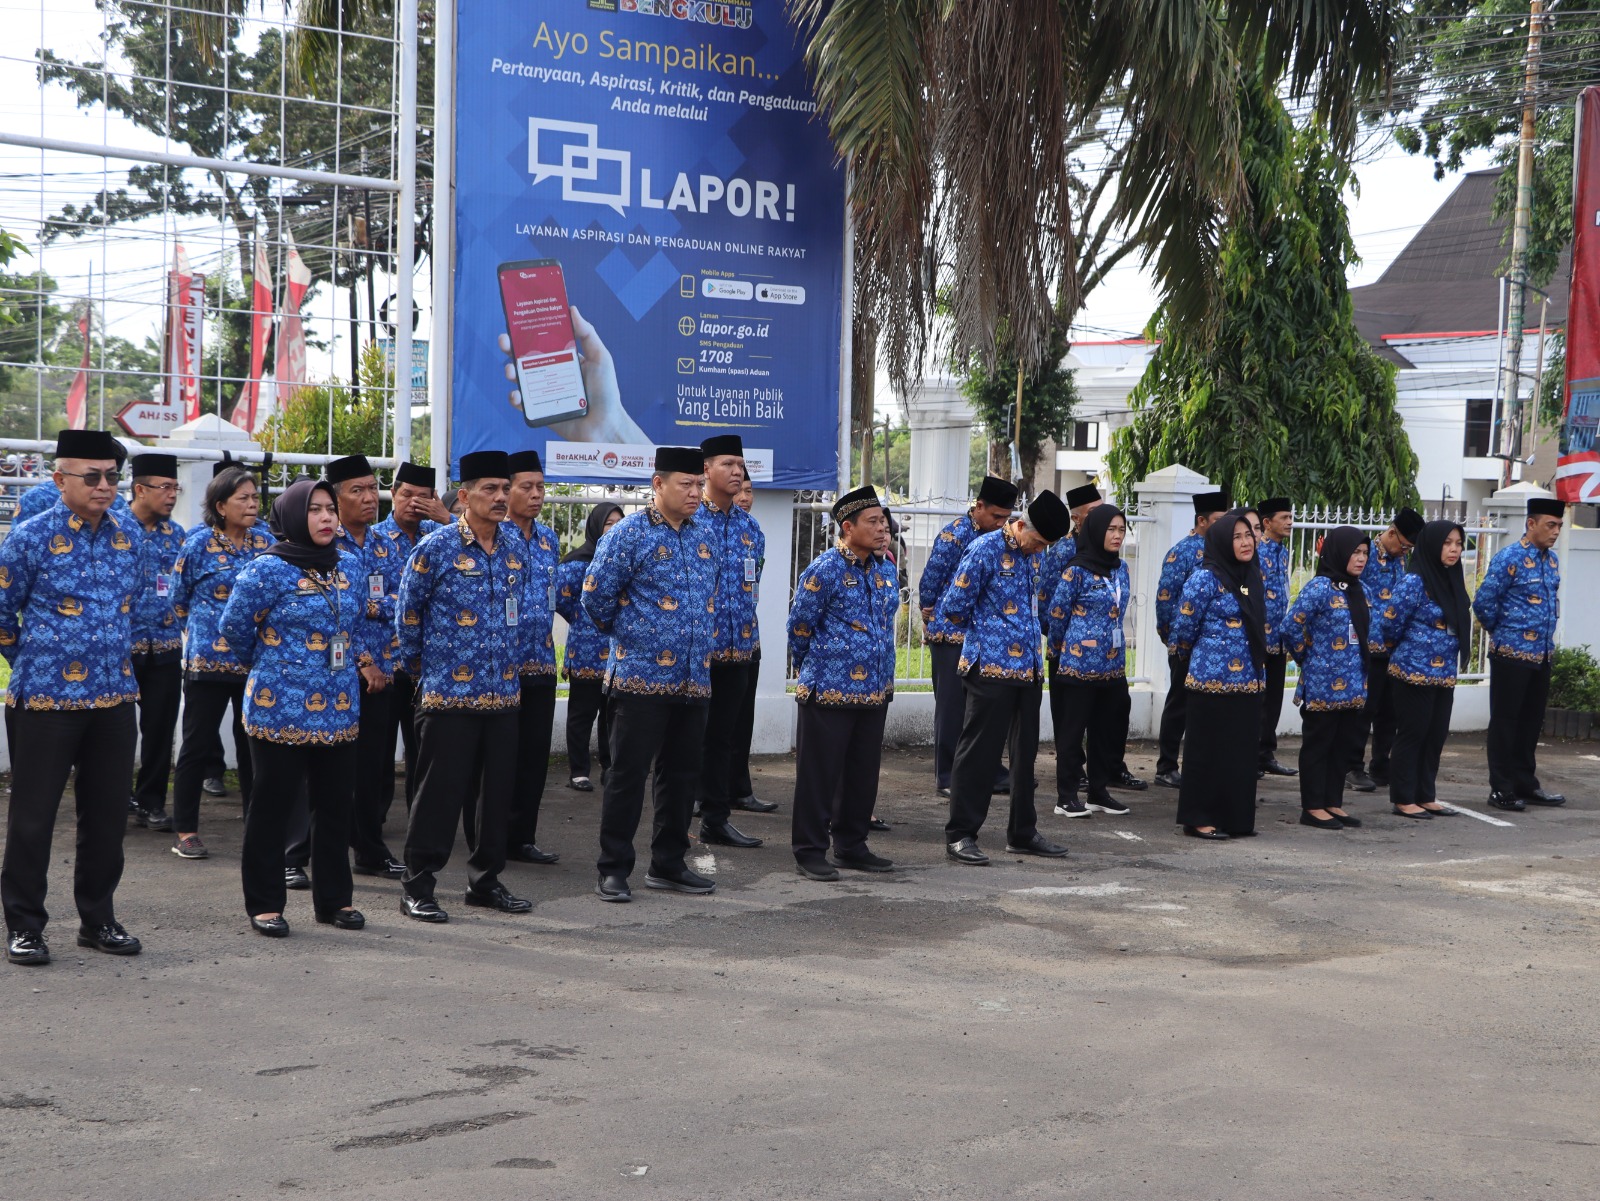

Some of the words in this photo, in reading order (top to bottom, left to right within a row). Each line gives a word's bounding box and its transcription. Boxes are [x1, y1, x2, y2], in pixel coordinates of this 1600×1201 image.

[620, 0, 752, 29] BENGKULU
[532, 21, 589, 60] Ayo
[599, 30, 779, 81] Sampaikan...
[491, 58, 586, 87] Pertanyaan,
[589, 71, 655, 95] Aspirasi,
[660, 80, 704, 102] Kritik,
[707, 86, 735, 103] dan
[738, 90, 817, 113] Pengaduan
[611, 96, 651, 115] Anda
[653, 103, 709, 122] melalui
[640, 168, 796, 222] LAPOR!
[515, 223, 569, 239] LAYANAN
[572, 229, 624, 244] ASPIRASI
[628, 233, 651, 246] DAN
[654, 235, 722, 252] PENGADUAN
[725, 242, 764, 256] ONLINE
[767, 246, 807, 259] RAKYAT
[700, 269, 720, 277] Mobile
[720, 270, 735, 278] Apps
[719, 287, 736, 295] Google
[770, 292, 782, 300] App
[699, 320, 770, 339] lapor.go.id
[712, 340, 744, 349] Pengaduan
[699, 349, 733, 364] 1708
[698, 365, 727, 374] Kumham
[727, 367, 749, 376] (spasi)
[749, 368, 770, 376] Aduan
[677, 383, 707, 398] Untuk
[710, 385, 750, 402] Layanan
[753, 387, 784, 402] Publik
[138, 410, 178, 422] AHASS
[677, 397, 710, 421] Yang
[714, 399, 751, 418] Lebih
[755, 401, 784, 419] Baik
[556, 450, 599, 461] BerAKHLAK
